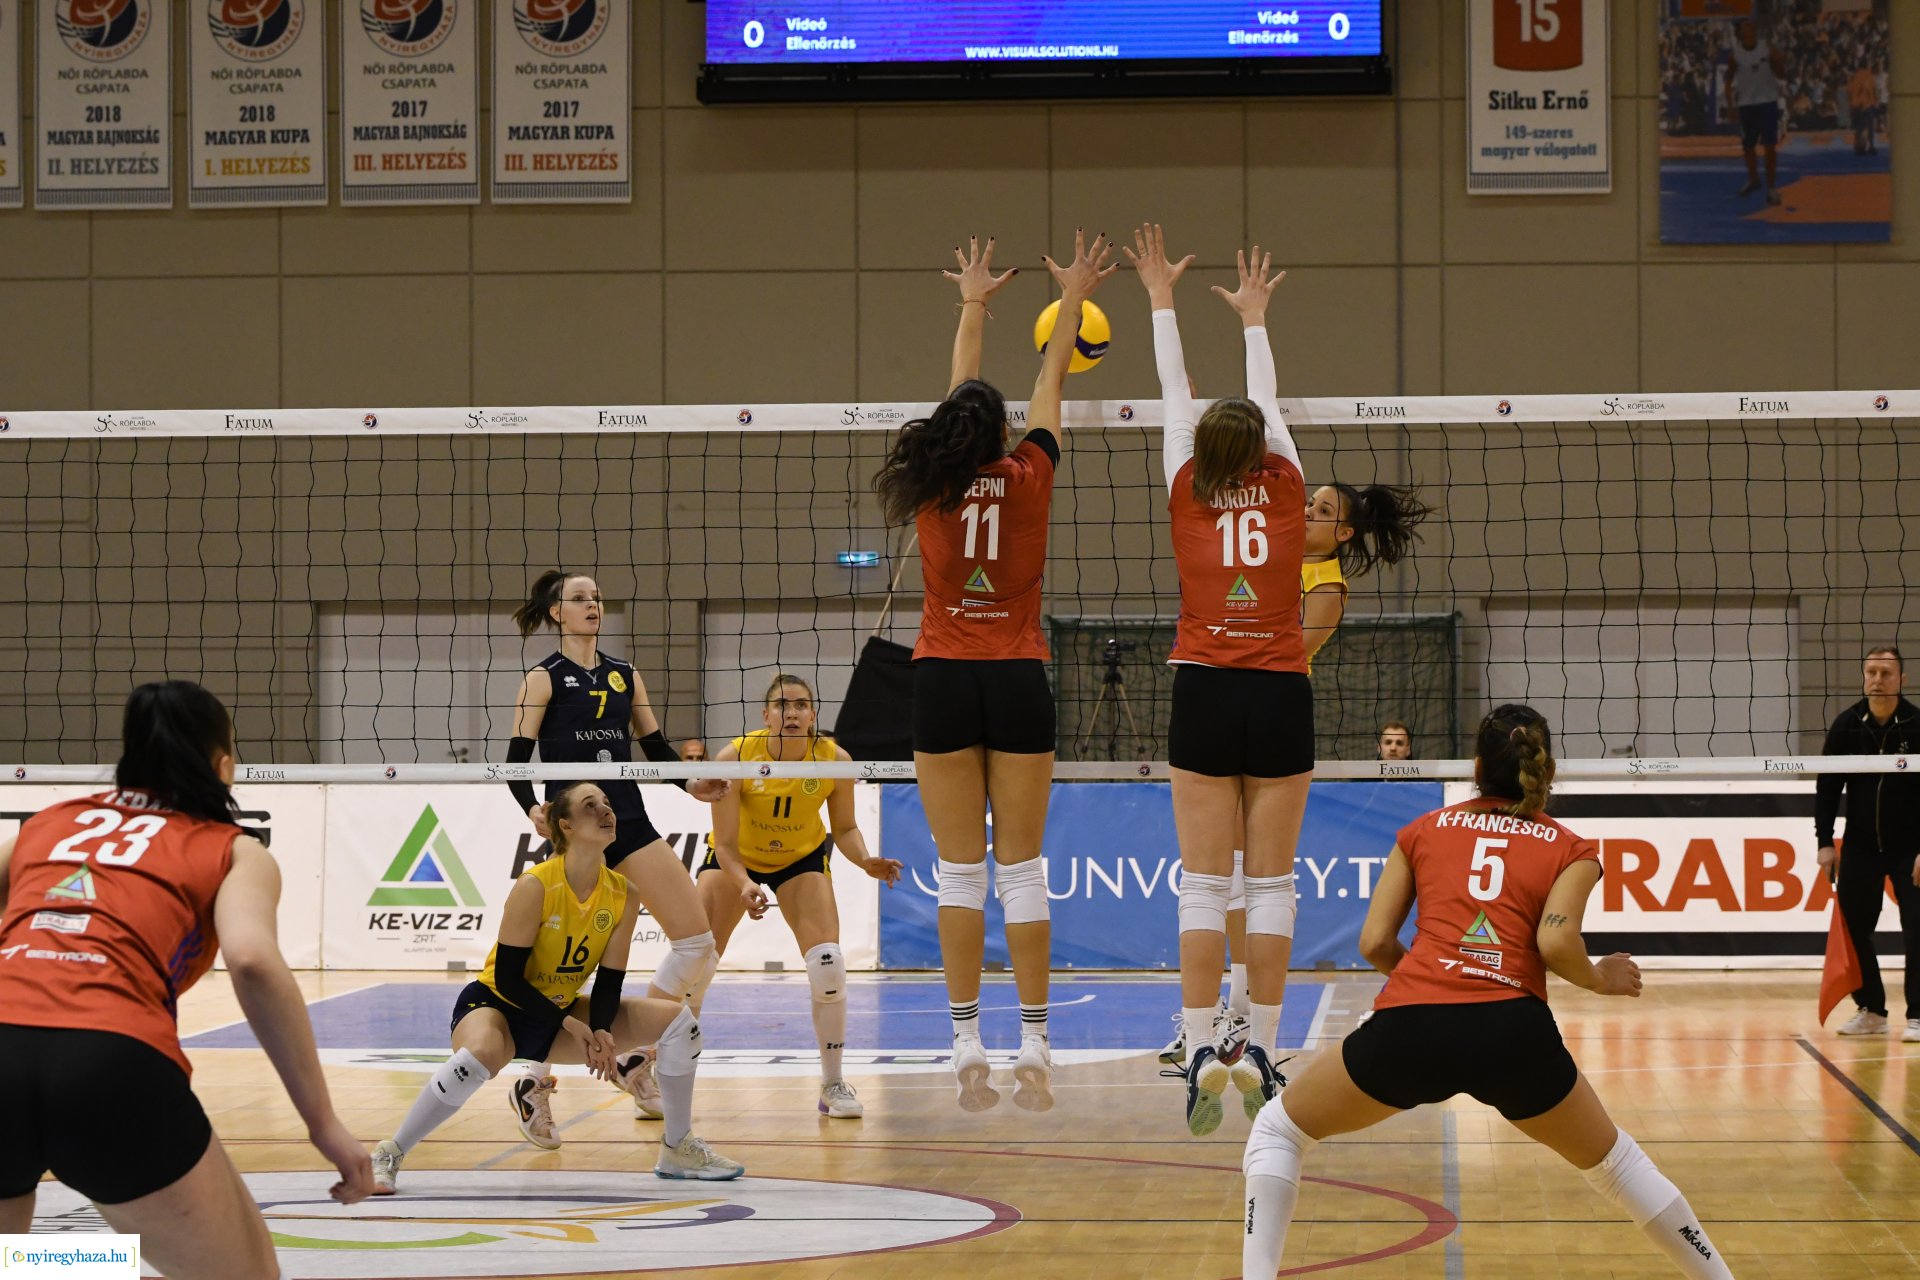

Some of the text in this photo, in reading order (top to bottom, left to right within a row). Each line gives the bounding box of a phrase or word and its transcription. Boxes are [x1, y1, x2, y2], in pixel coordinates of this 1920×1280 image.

[786, 17, 827, 31] Videó
[1258, 10, 1299, 25] Videó
[1516, 0, 1560, 42] 15
[743, 20, 765, 48] 0
[1328, 13, 1349, 40] 0
[965, 45, 1119, 58] WWW.VISUALSOLUTIONS.HU
[76, 84, 130, 94] CSAPATA
[230, 83, 284, 94] CSAPATA
[382, 79, 436, 89] CSAPATA
[533, 79, 589, 89] CSAPATA
[1489, 90, 1588, 110] Sitku Ernő
[86, 106, 121, 122] 2018
[239, 105, 275, 122] 2018
[391, 101, 428, 118] 2017
[543, 101, 579, 118] 2017
[48, 126, 159, 146] MAGYAR BAJNOKSÁG
[205, 129, 310, 146] MAGYAR KUPA
[353, 119, 467, 141] MAGYAR BAJNOKSÁG
[508, 125, 615, 141] MAGYAR KUPA
[1505, 125, 1573, 139] 149-szeres
[354, 147, 467, 171] III. HELYEZÉS
[504, 148, 618, 171] III. HELYEZÉS
[1481, 142, 1597, 160] magyar válogatott
[48, 153, 159, 175] II. HELYEZÉS
[205, 152, 310, 176] I. HELYEZÉS
[1355, 402, 1406, 417] FATUM
[1738, 397, 1789, 412] FATUM
[224, 414, 274, 429] FATUM
[598, 410, 648, 425] FATUM
[961, 503, 1000, 560] 11
[1216, 510, 1269, 567] 16
[589, 691, 608, 718] 7
[245, 768, 285, 779] FATUM
[620, 765, 659, 777] FATUM
[1379, 763, 1420, 776] FATUM
[1764, 759, 1804, 771] FATUM
[773, 796, 792, 818] 11
[1437, 811, 1558, 843] K-FRANCESCO
[48, 808, 167, 866] 23
[1468, 837, 1509, 901] 5
[368, 913, 483, 931] KE-VIZ 21
[560, 935, 589, 966] 16
[1462, 966, 1521, 988] BESTRONG
